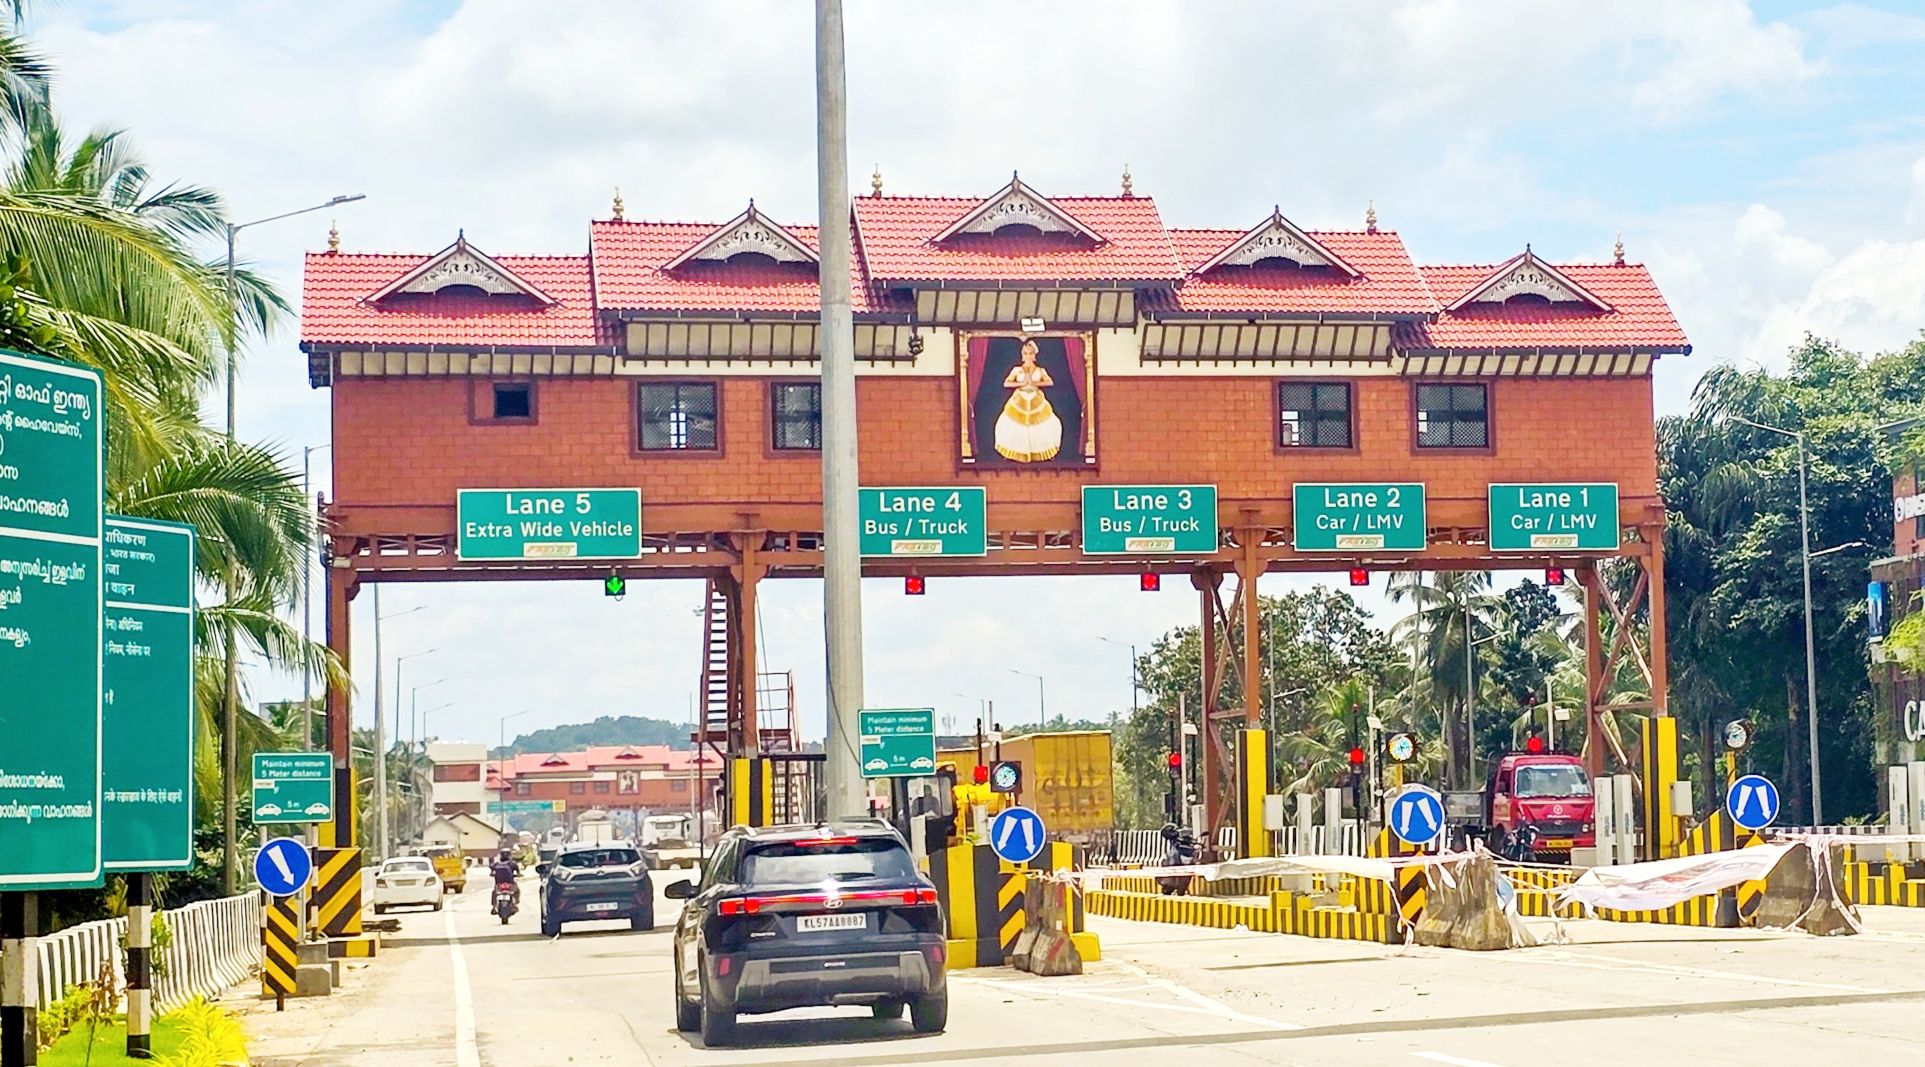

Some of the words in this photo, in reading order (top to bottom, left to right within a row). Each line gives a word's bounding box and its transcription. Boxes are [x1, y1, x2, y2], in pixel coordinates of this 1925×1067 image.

[15, 382, 52, 404] ഓഫ്
[53, 389, 91, 420] ഇന്ത്യ
[506, 493, 565, 515] Lane
[575, 493, 592, 514] 5
[880, 491, 936, 513] Lane
[944, 491, 962, 512] 4
[1113, 489, 1168, 511] Lane
[1178, 489, 1192, 510] 3
[1324, 487, 1377, 508] Lane
[1386, 487, 1401, 508] 2
[1519, 487, 1571, 508] Lane
[1580, 487, 1588, 508] 1
[466, 522, 513, 538] Extra
[520, 522, 563, 537] Wide
[569, 521, 633, 537] Vehicle
[865, 519, 898, 535] Bus
[905, 517, 913, 537] /
[918, 518, 968, 535] Truck
[1100, 517, 1132, 532] Bus
[1138, 515, 1146, 534] /
[1151, 516, 1200, 532] Truck
[1316, 514, 1347, 530] Car
[1352, 513, 1360, 531] /
[1367, 514, 1404, 530] LMV
[1511, 514, 1541, 530] Car
[1547, 513, 1554, 531] /
[1561, 514, 1597, 530] LMV
[261, 760, 293, 768] Maintain
